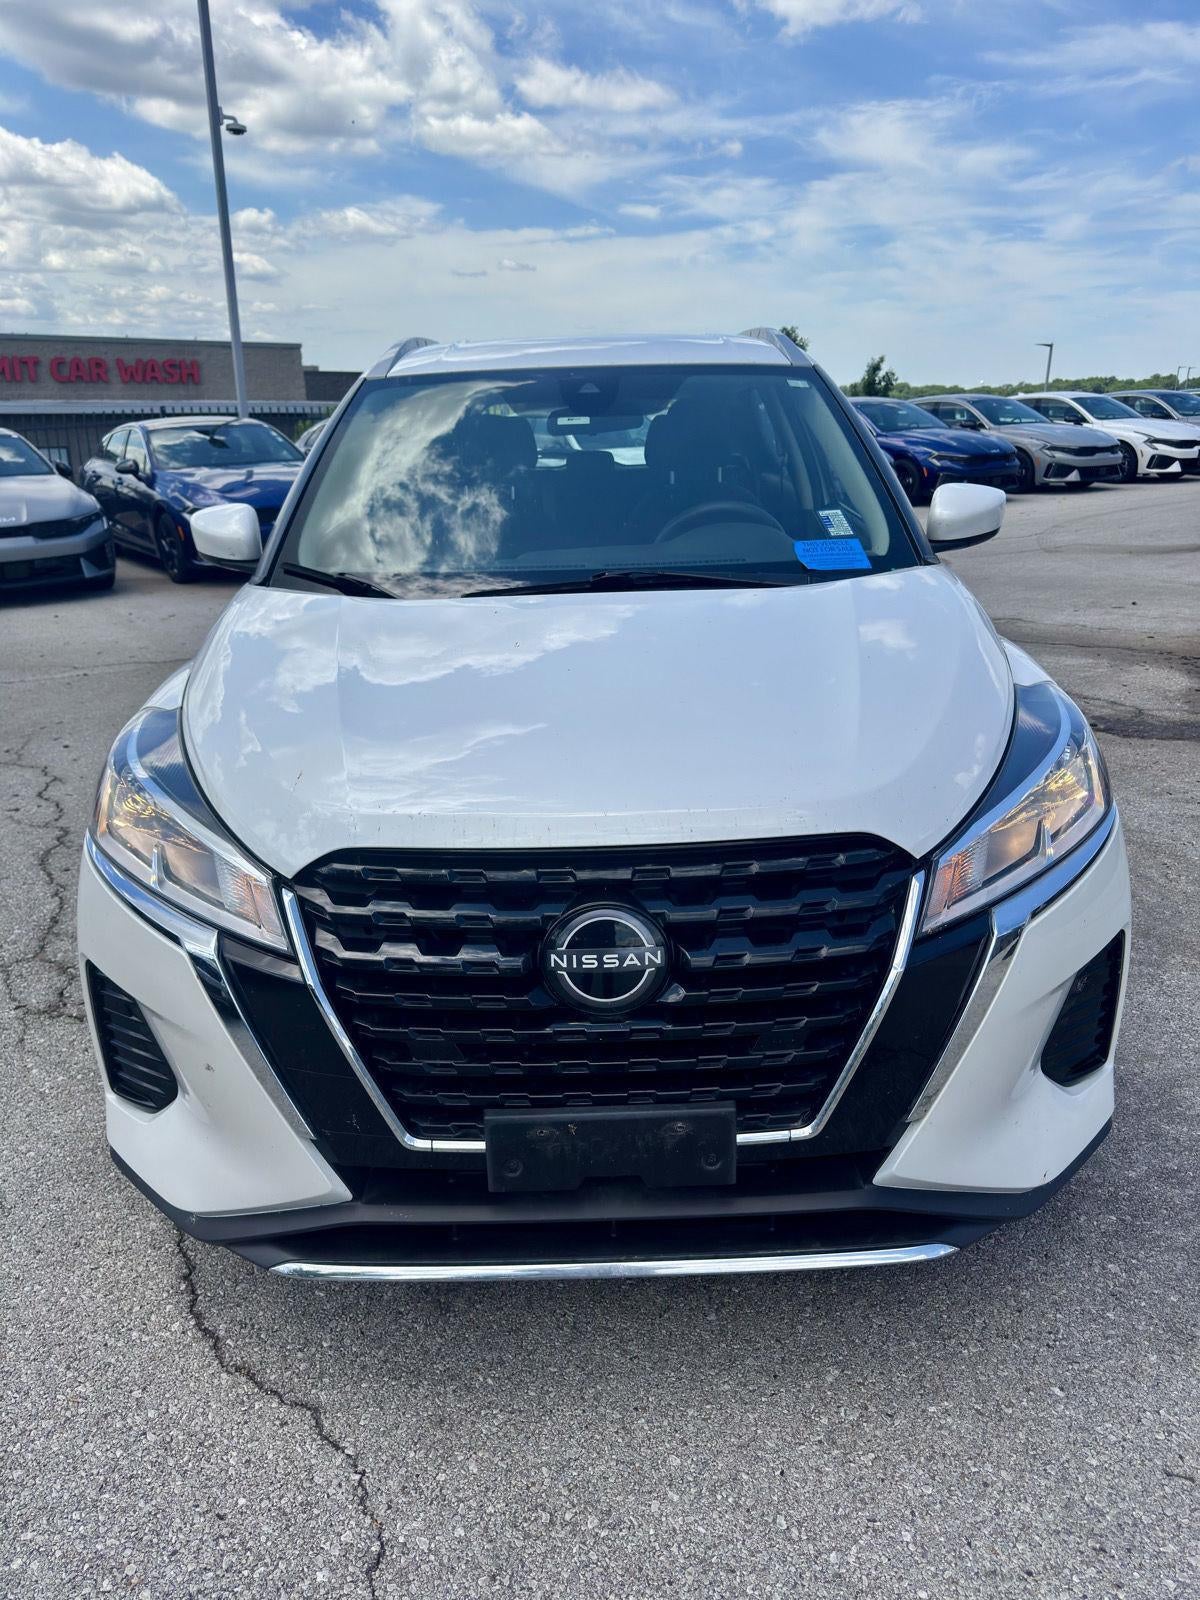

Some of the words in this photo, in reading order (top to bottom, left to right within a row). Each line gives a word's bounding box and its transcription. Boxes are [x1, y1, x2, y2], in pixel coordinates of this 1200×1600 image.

[50, 357, 108, 381] CAR
[117, 358, 201, 384] WASH
[550, 950, 661, 969] NISSAN
